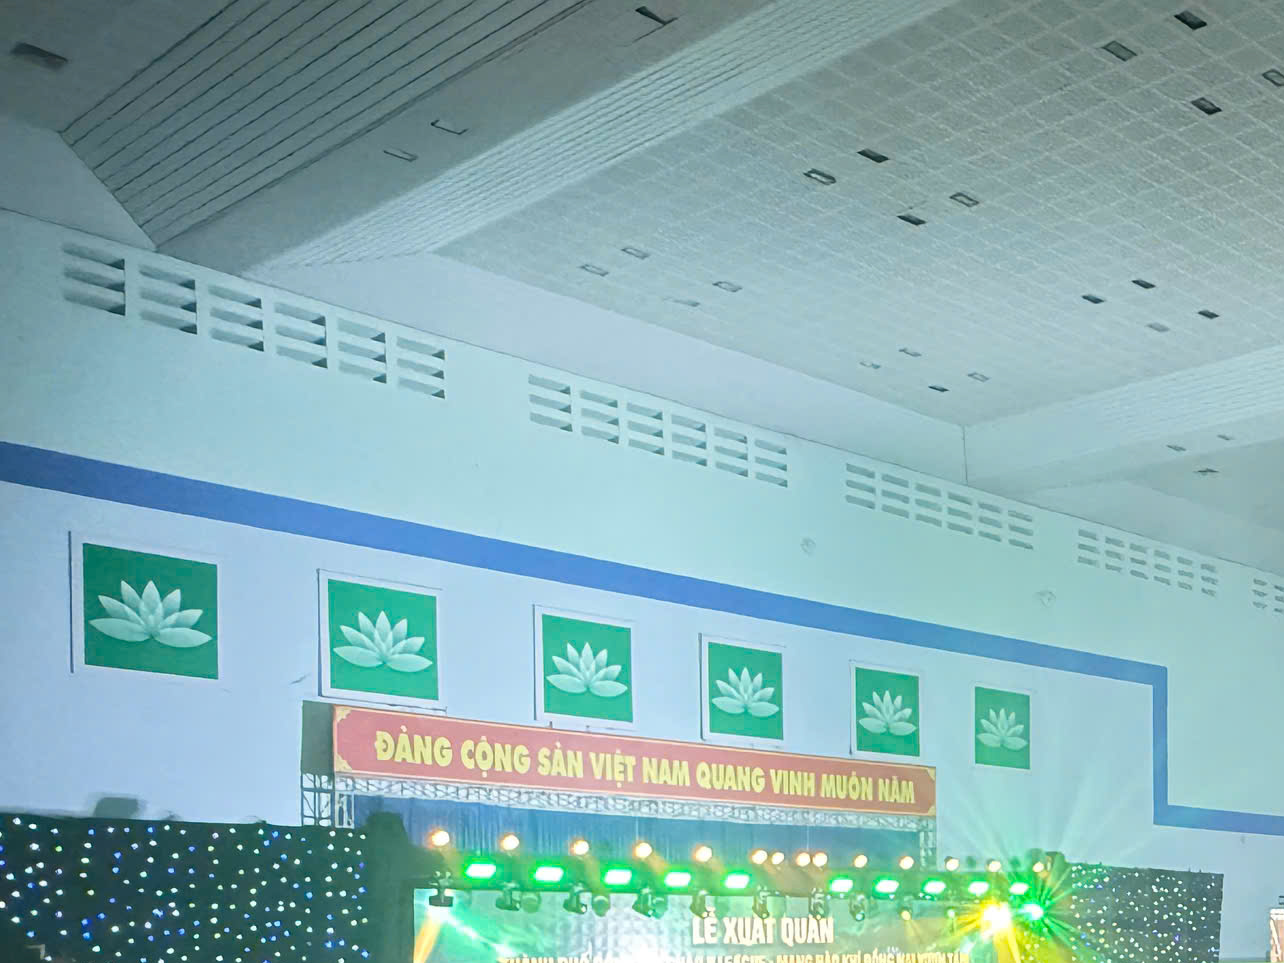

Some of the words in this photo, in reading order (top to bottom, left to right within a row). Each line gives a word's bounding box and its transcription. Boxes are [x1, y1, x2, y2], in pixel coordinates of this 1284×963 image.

[374, 725, 453, 767] ĐẢNG
[461, 735, 531, 778] CỘNG
[537, 741, 584, 778] SẢN
[589, 749, 637, 788] VIỆT
[642, 756, 691, 787] NAM
[696, 761, 766, 793] QUANG
[770, 769, 816, 797] VINH
[820, 771, 873, 801] MUÔN
[878, 775, 915, 804] NĂM
